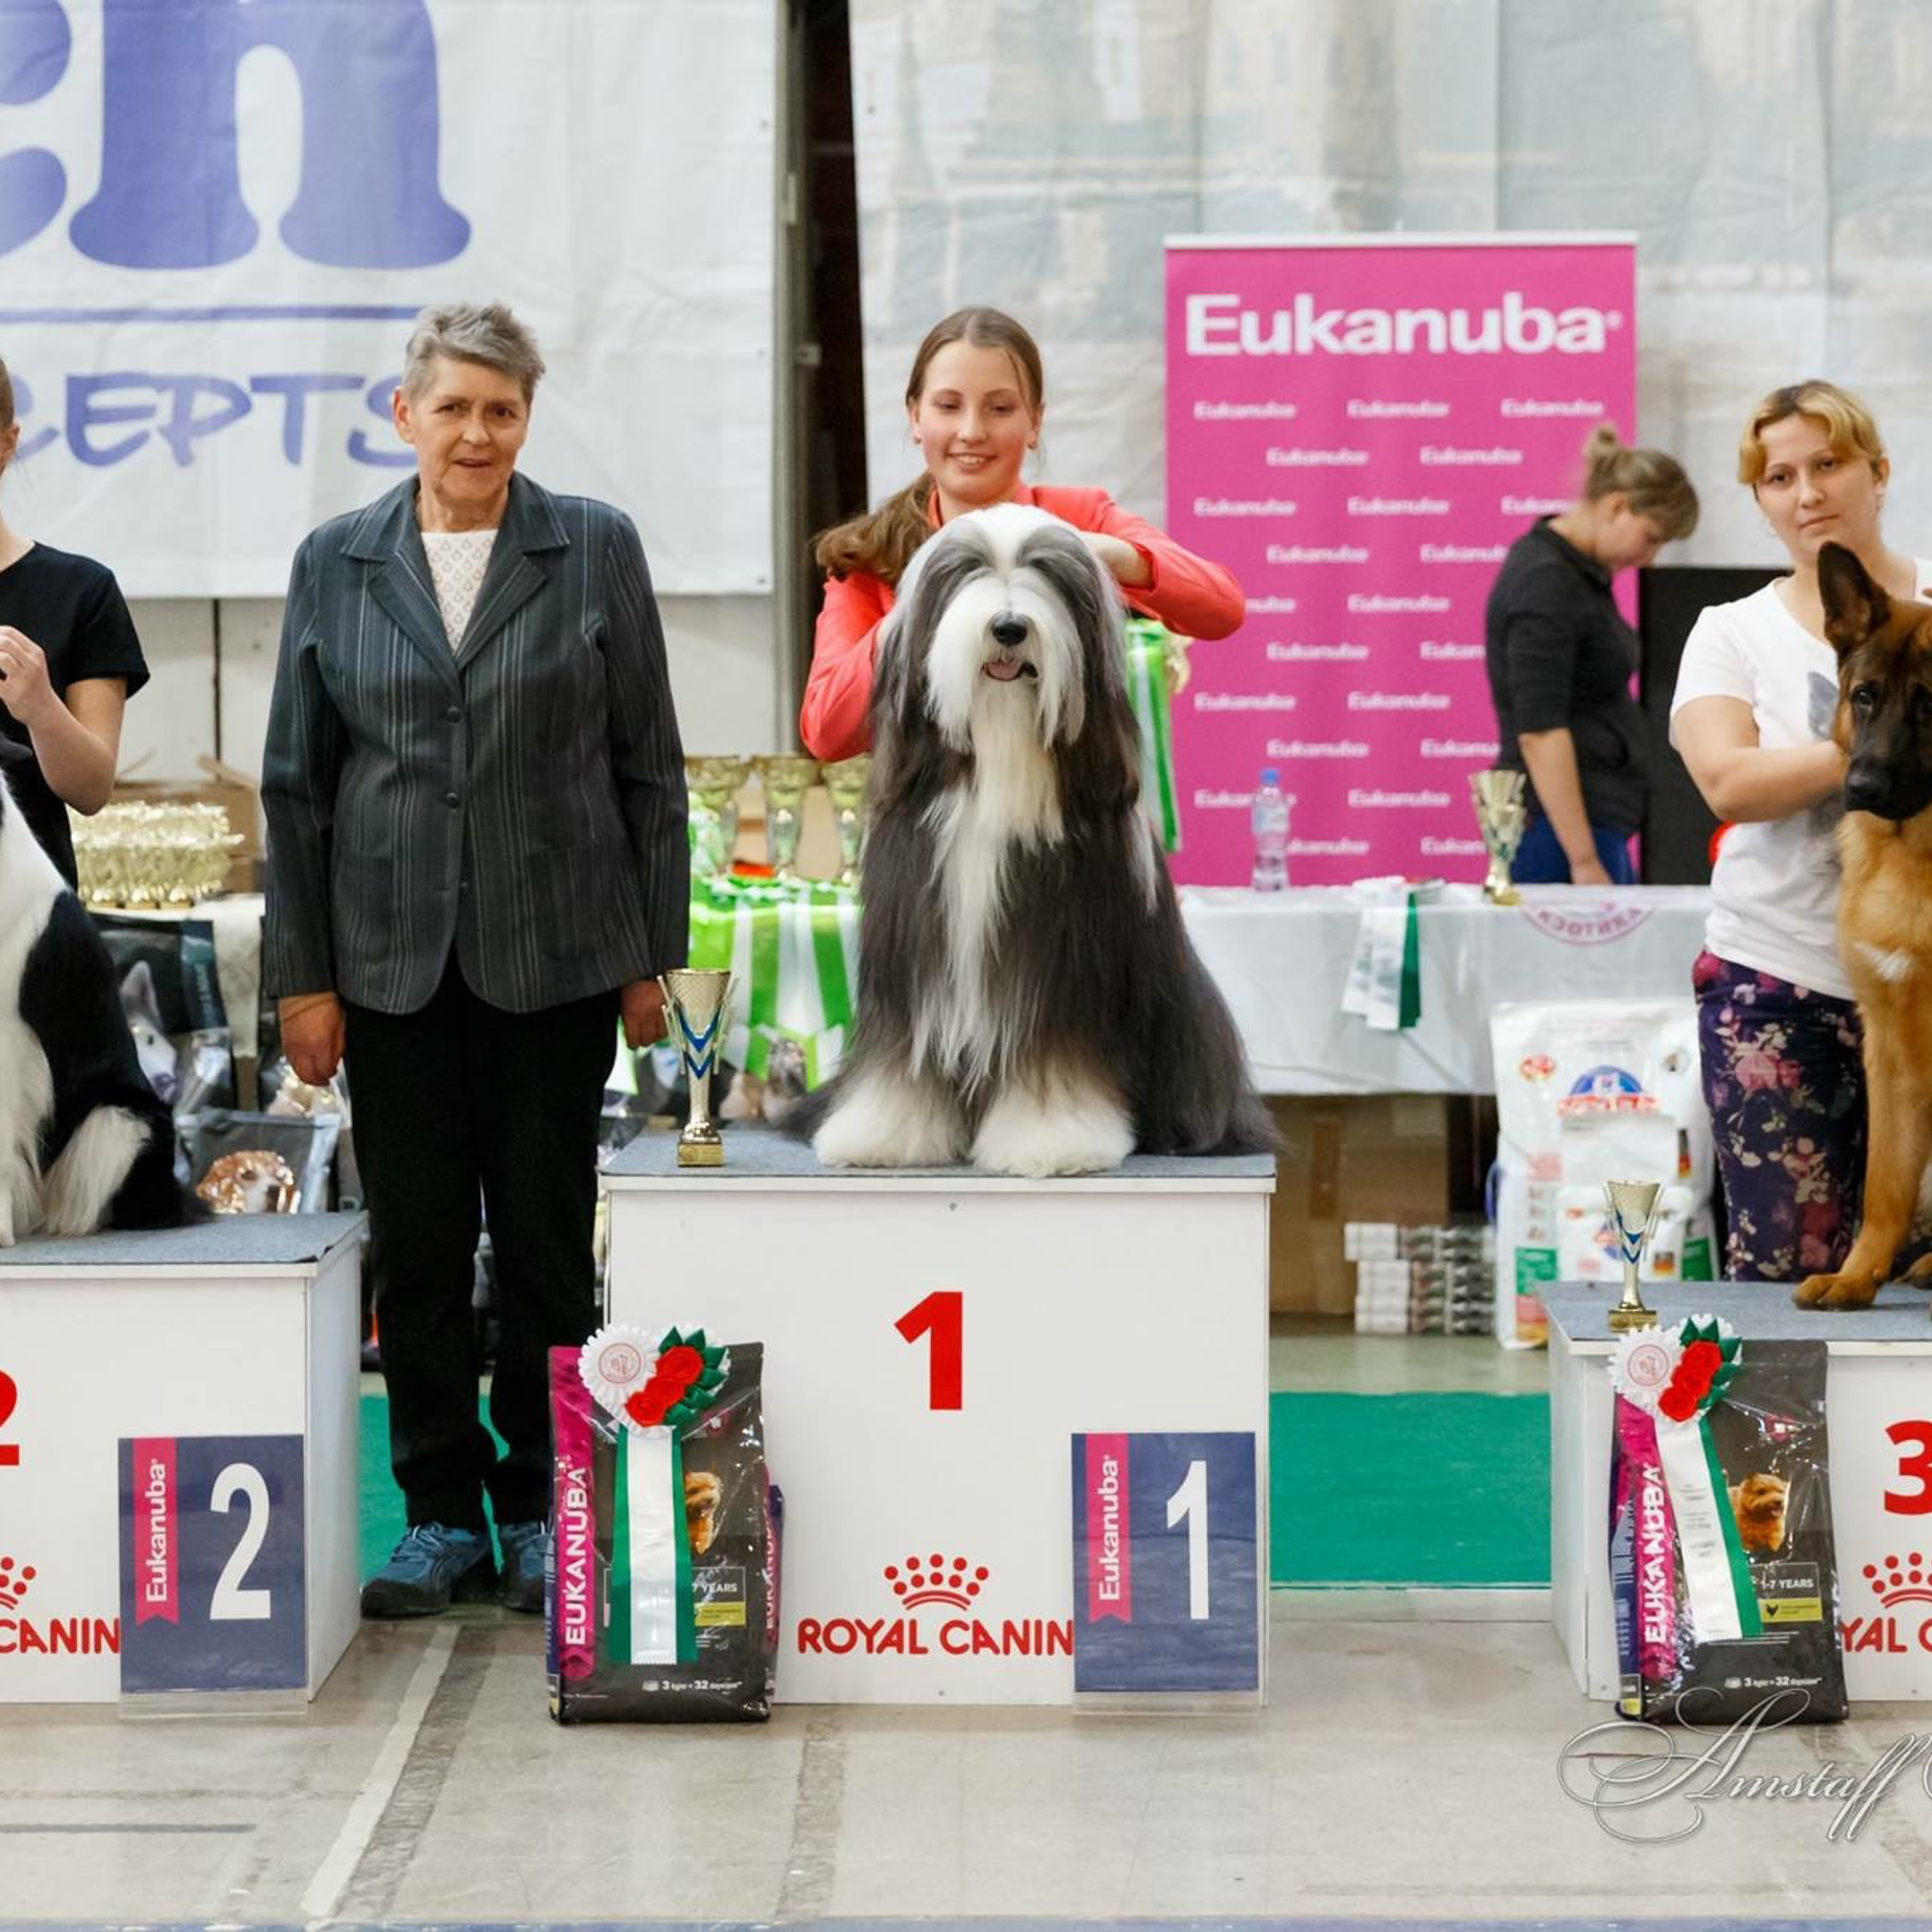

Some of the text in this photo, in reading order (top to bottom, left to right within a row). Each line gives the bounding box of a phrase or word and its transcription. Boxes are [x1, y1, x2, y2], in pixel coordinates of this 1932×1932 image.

[895, 1292, 961, 1410] 1
[145, 1459, 168, 1602] Eukanuba
[1098, 1455, 1121, 1601] Eukanuba
[1884, 1420, 1932, 1515] 3
[210, 1463, 271, 1621] 2
[567, 1468, 588, 1646] EUKANUBA
[1167, 1460, 1209, 1620] 1
[1779, 1578, 1814, 1589] YEARS
[798, 1618, 1072, 1655] ROYAL CANIN
[1837, 1617, 1907, 1653] YAL
